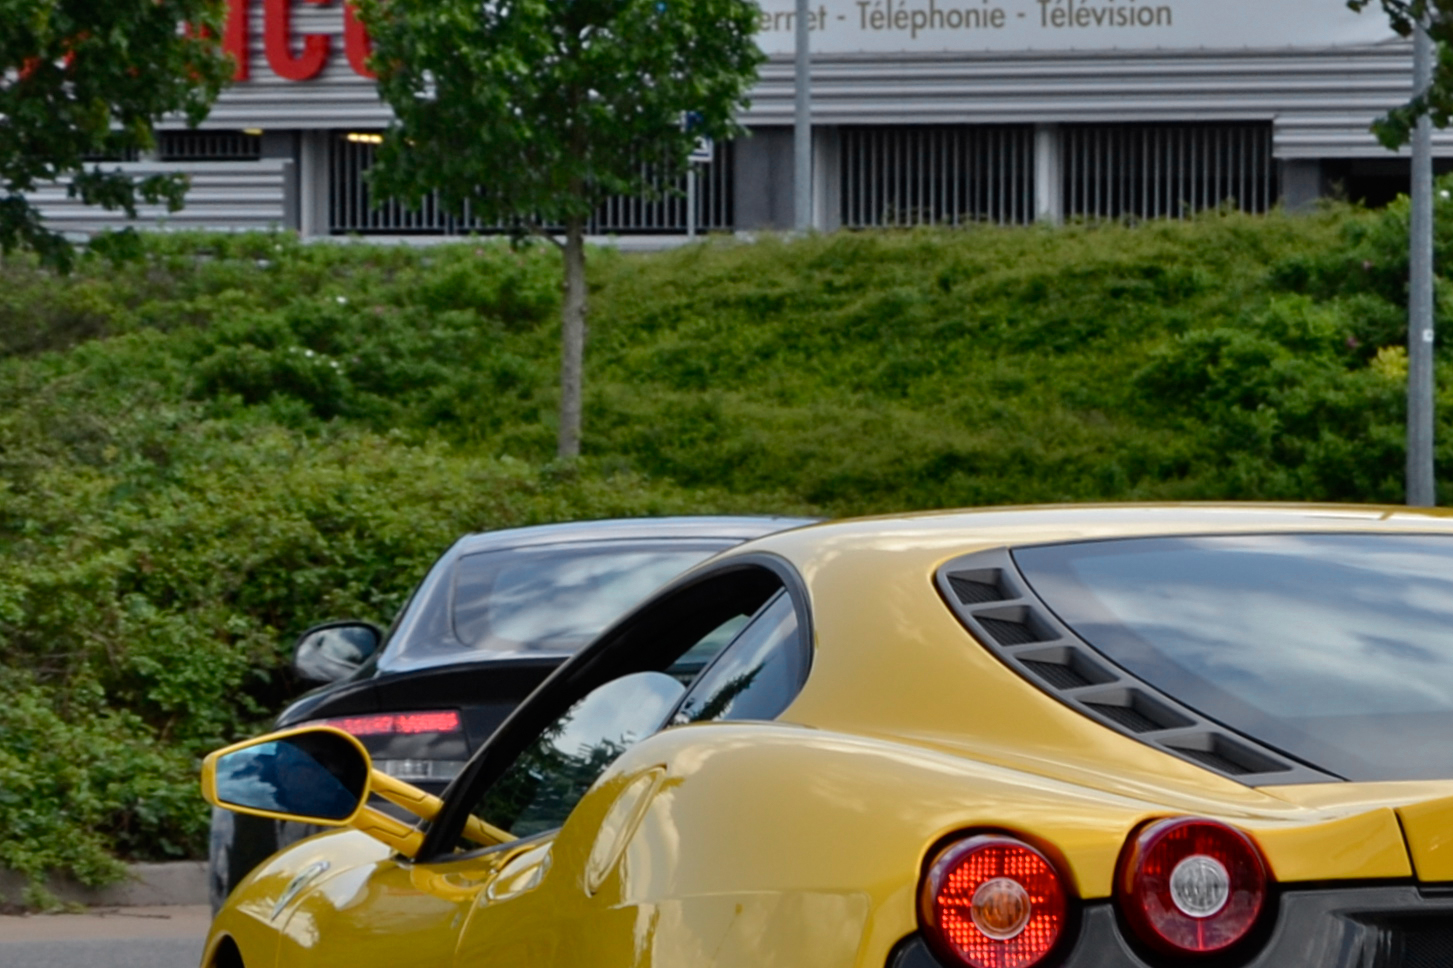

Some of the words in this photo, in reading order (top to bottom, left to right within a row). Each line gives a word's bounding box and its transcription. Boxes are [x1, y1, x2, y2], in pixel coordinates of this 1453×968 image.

[759, 5, 827, 31] ernet
[857, 0, 1006, 39] Téléphonie
[1037, 0, 1172, 28] Télévision
